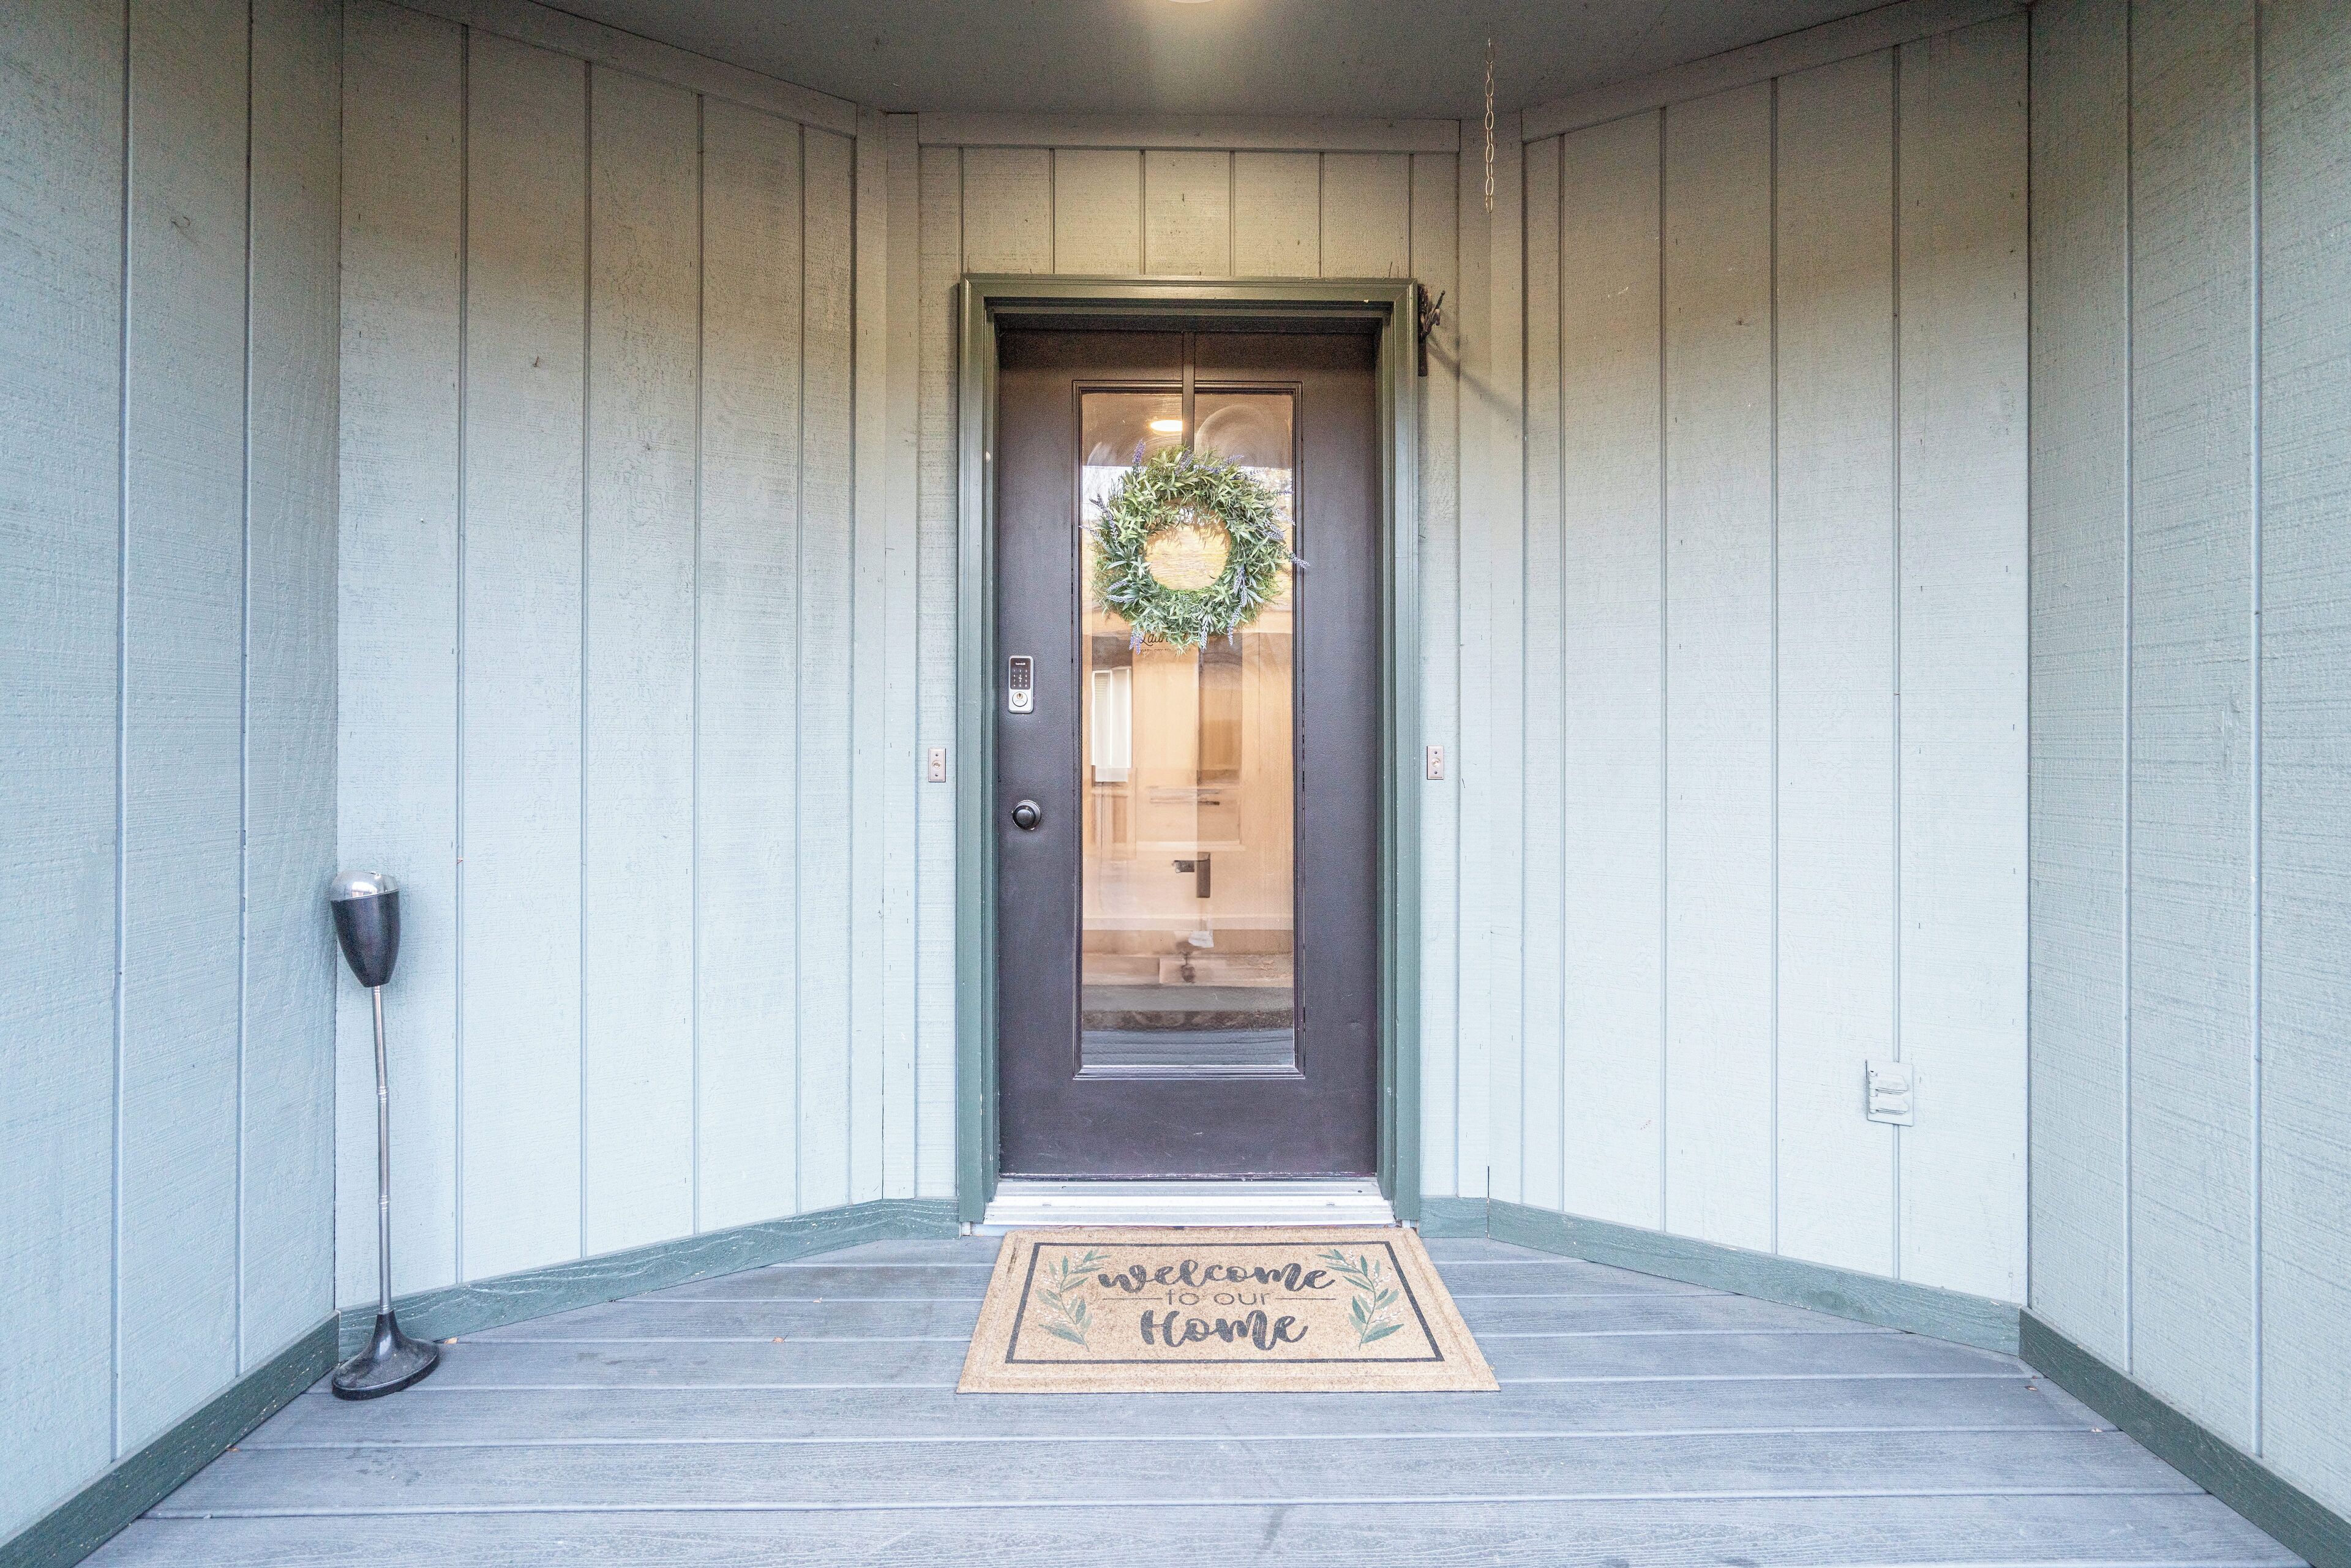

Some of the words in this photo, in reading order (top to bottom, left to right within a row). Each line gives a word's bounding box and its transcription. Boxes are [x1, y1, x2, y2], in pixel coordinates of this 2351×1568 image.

[1098, 1259, 1336, 1293] welcome
[1166, 1289, 1201, 1305] to
[1213, 1291, 1271, 1305] our
[1141, 1309, 1309, 1351] Home
